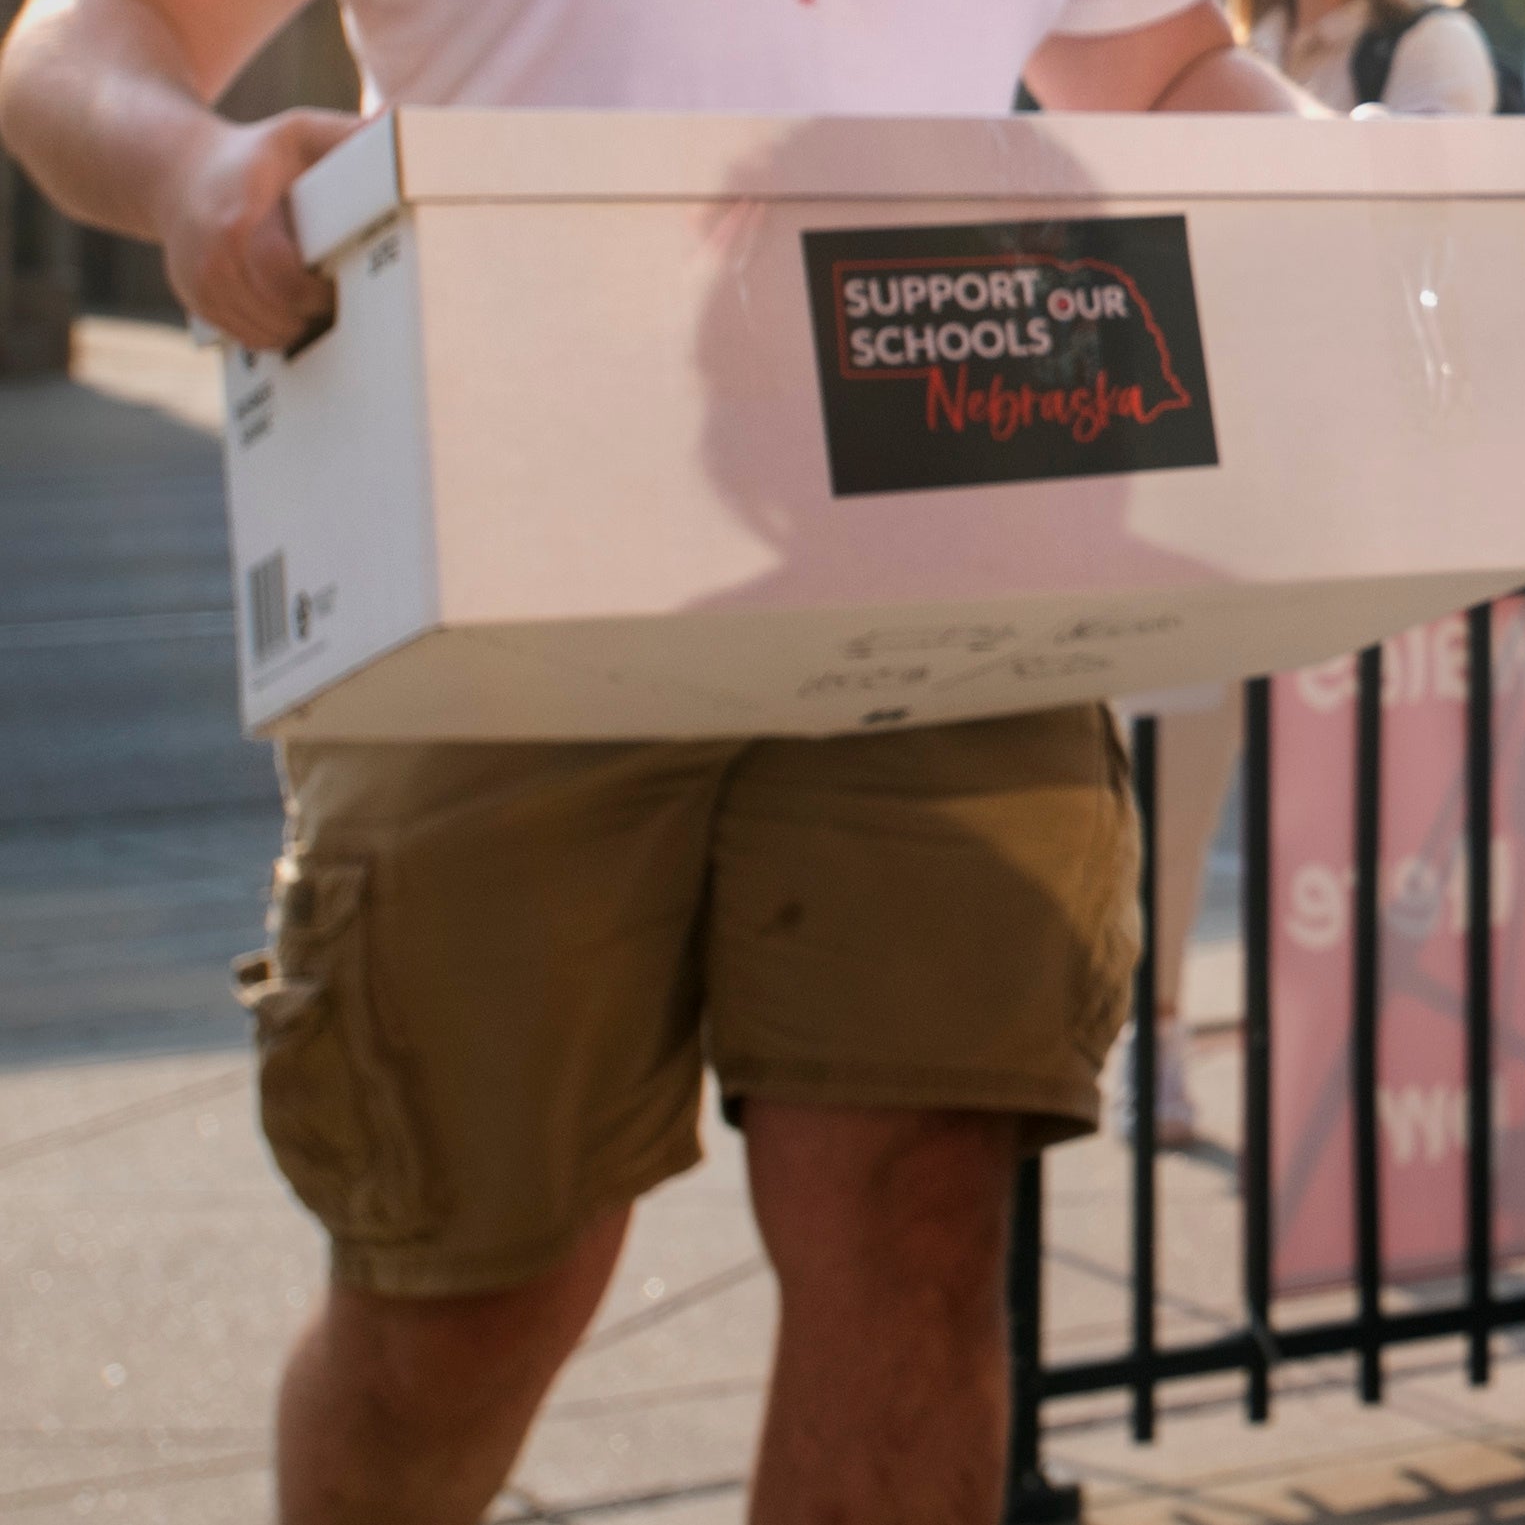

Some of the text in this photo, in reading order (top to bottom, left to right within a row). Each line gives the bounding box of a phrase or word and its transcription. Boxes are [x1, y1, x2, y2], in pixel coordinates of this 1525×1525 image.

[844, 269, 1129, 322] SUPPORT OUR
[850, 317, 1052, 368] SCHOOLS
[927, 363, 1150, 443] Nebraska
